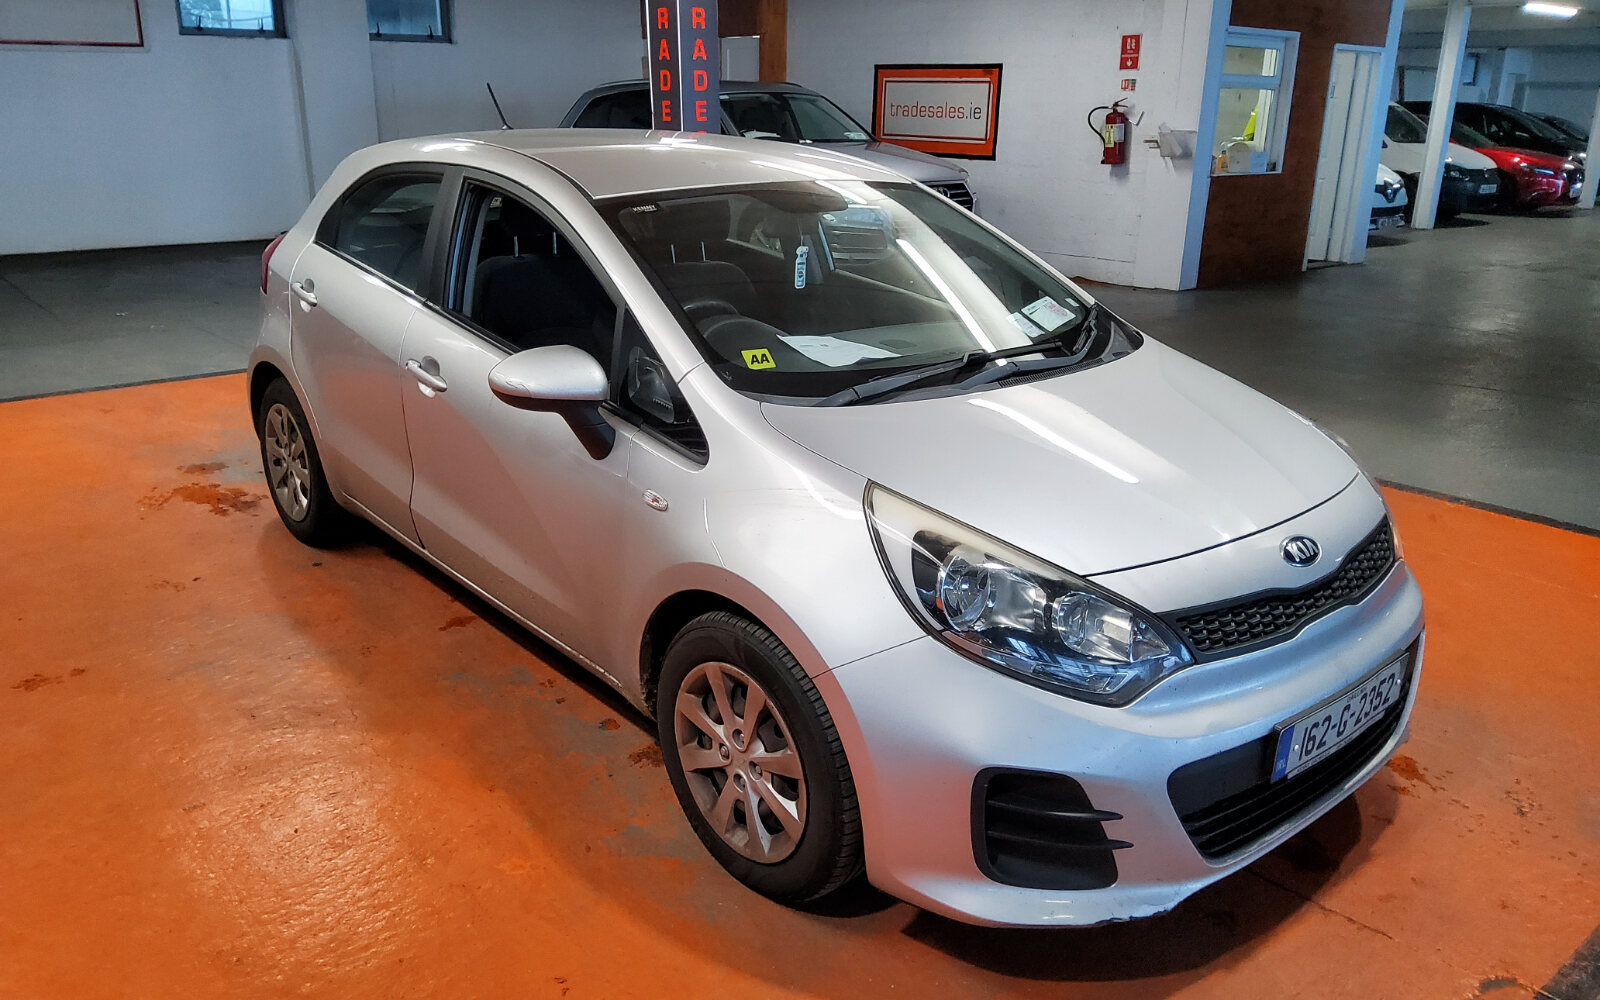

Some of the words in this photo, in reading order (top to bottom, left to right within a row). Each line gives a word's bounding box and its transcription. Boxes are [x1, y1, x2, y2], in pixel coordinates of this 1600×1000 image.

[691, 7, 708, 134] RADE
[890, 100, 982, 120] tradesales.ie
[751, 353, 770, 365] AA
[1286, 539, 1319, 562] KIA
[1298, 672, 1395, 761] 162-G-2352
